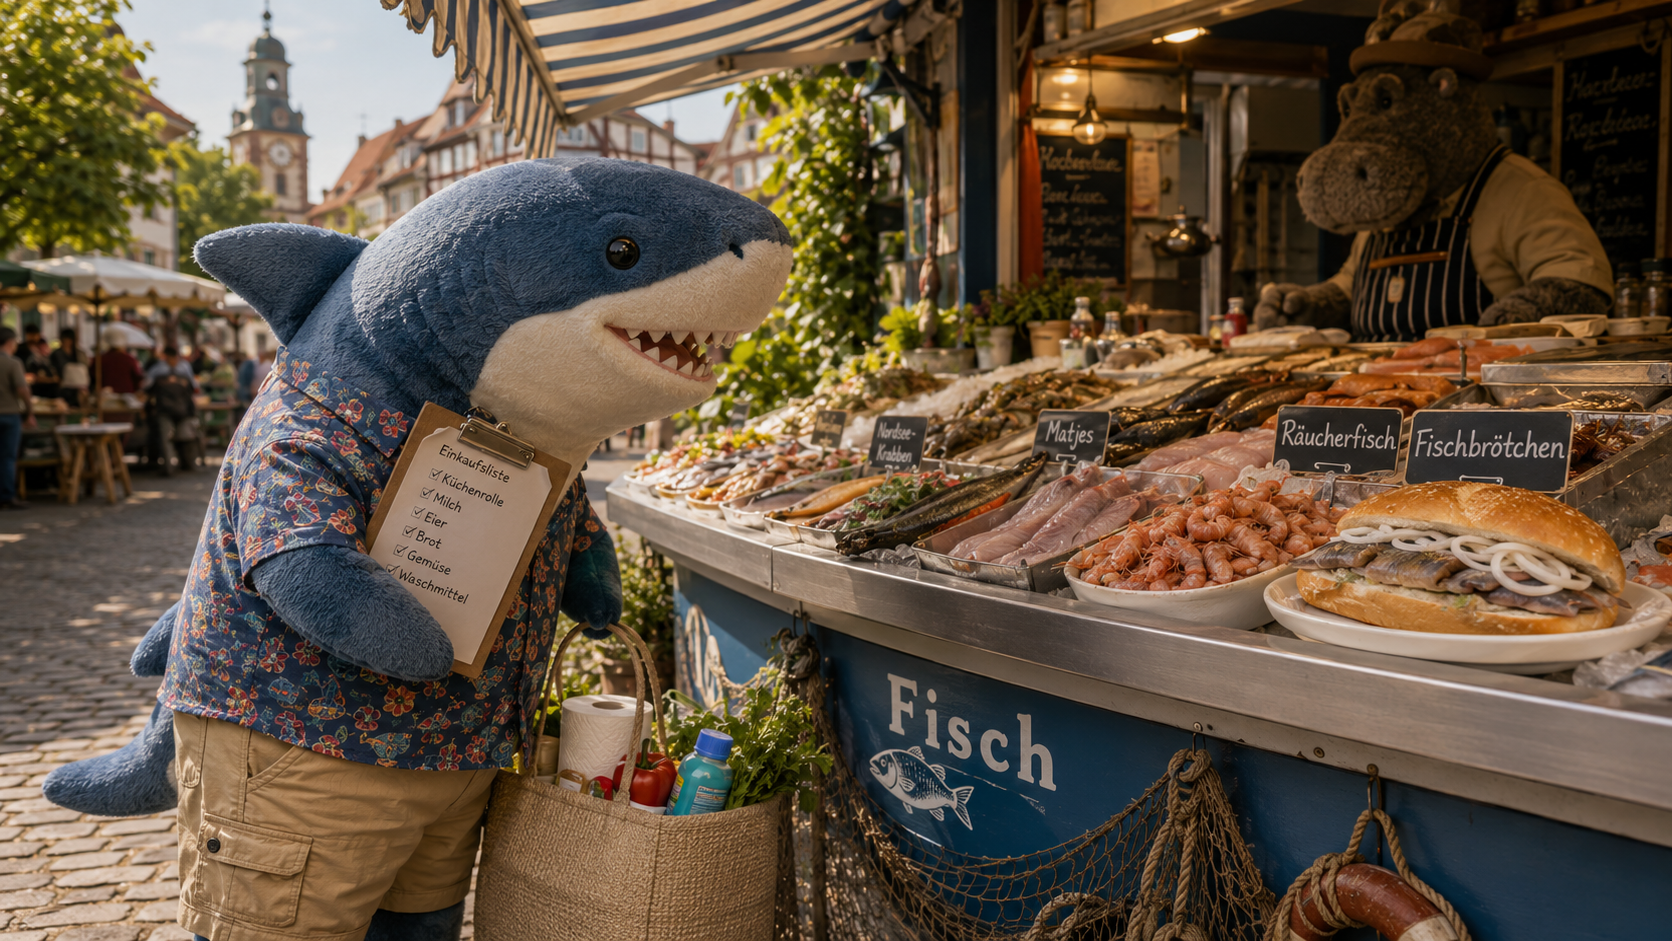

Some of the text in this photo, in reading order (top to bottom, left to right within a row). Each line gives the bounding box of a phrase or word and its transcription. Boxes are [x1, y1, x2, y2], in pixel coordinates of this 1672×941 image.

[877, 421, 917, 441] Nordsee-
[1045, 420, 1094, 450] Matjes
[1281, 419, 1397, 450] Räucherfisch
[1415, 428, 1566, 459] Fischbrötchen
[438, 444, 511, 483] Einkaufsliste
[876, 443, 912, 463] Krabben
[433, 492, 463, 513] Milch
[441, 473, 505, 508] Küchenrolle
[424, 512, 448, 529] Eier
[415, 530, 443, 550] Brot
[407, 550, 451, 575] Gemüse
[399, 569, 469, 604] Waschmittel
[887, 673, 1057, 792] Fisch
